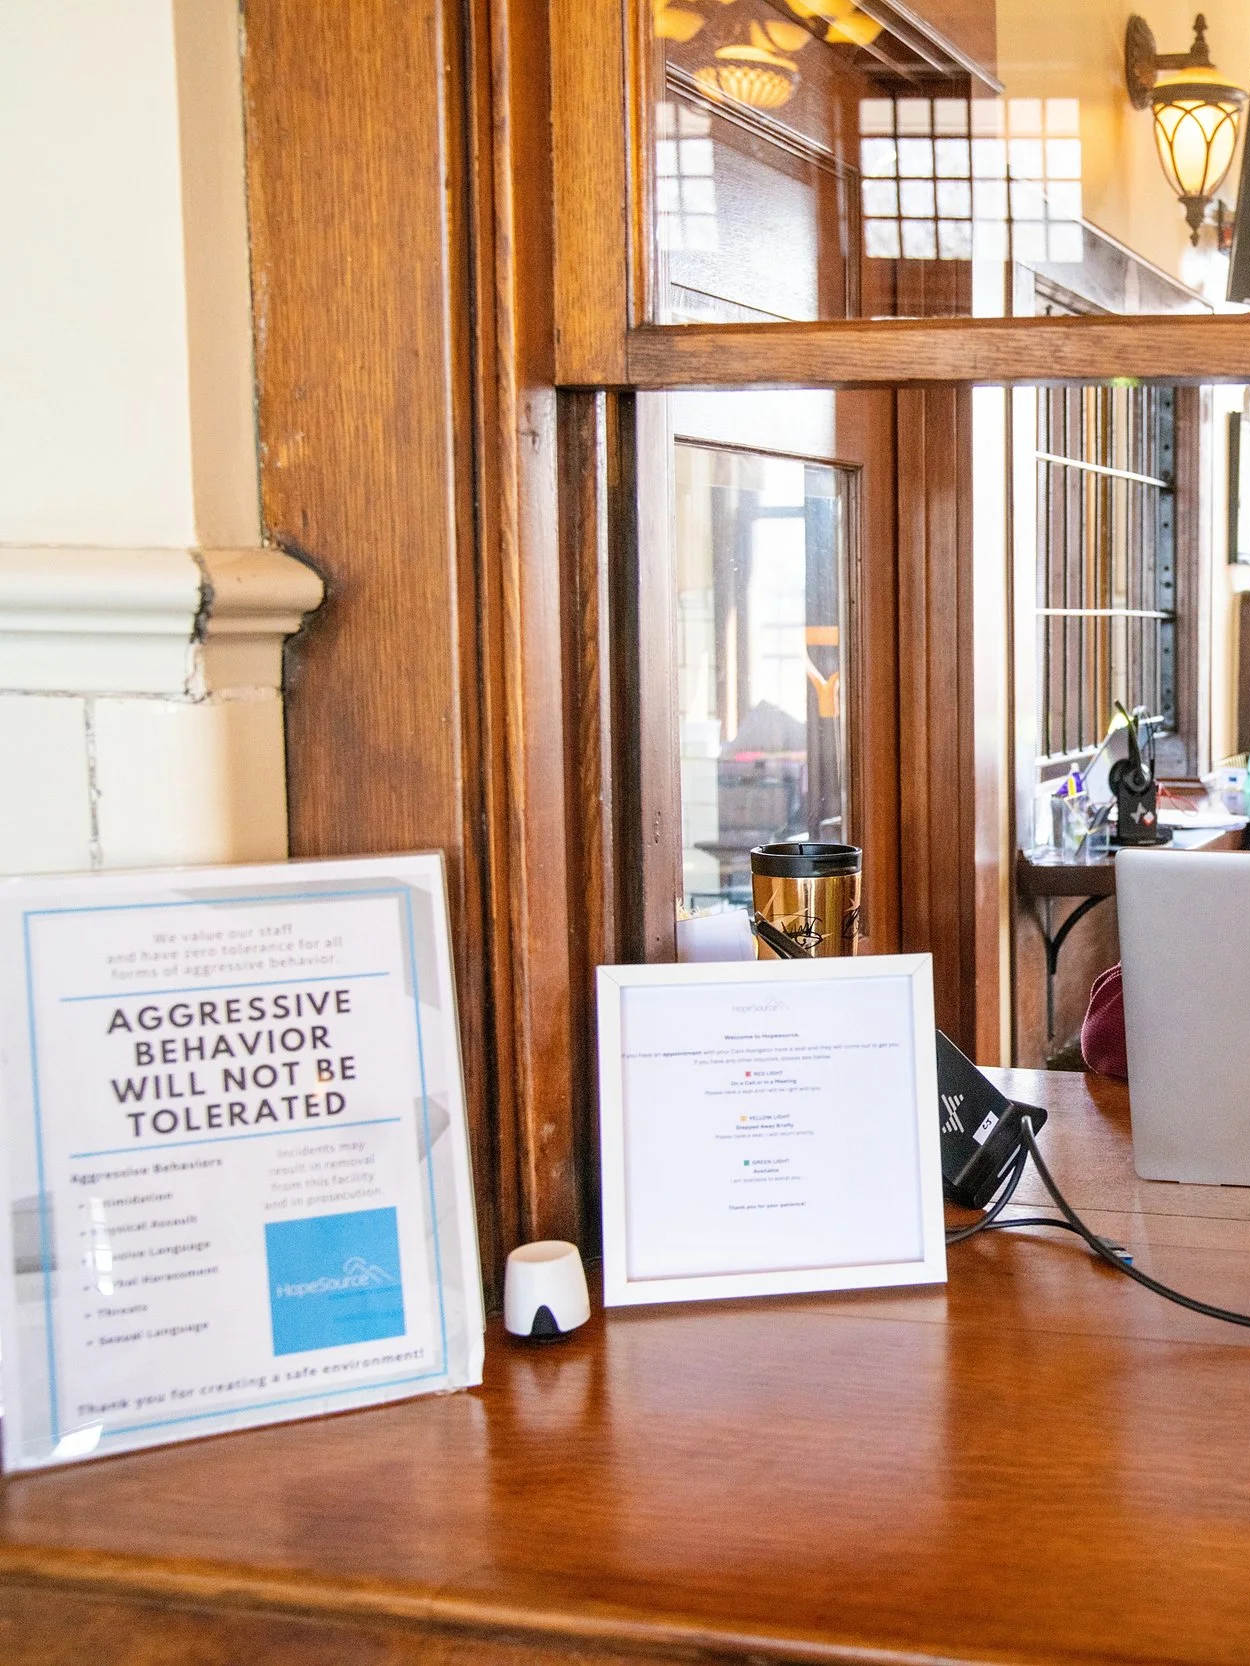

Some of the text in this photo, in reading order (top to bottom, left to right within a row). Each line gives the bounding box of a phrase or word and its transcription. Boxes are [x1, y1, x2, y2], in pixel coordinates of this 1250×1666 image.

[153, 924, 293, 944] We value our staff
[106, 936, 343, 965] and have zero tolerance for all
[111, 968, 158, 980] forms
[162, 966, 179, 977] of
[183, 960, 264, 977] aggressive
[106, 989, 351, 1035] AGGRESSIVE
[134, 1025, 332, 1067] BEHAVIOR
[662, 1050, 702, 1058] appointment
[111, 1056, 356, 1103] WILL NOT BE
[126, 1092, 346, 1138] TOLERATED
[276, 1142, 366, 1158] Incidents may
[69, 1158, 223, 1185] Aggressive Behaviors
[268, 1154, 376, 1176] result in removal
[271, 1172, 376, 1191] from this facility
[150, 1214, 198, 1229] Assault
[147, 1240, 211, 1257] Language
[141, 1265, 220, 1284] Harassment
[276, 1274, 370, 1298] HopeSource
[97, 1304, 149, 1319] Threats
[98, 1321, 210, 1346] Sexual Language
[78, 1399, 129, 1417] Thank
[136, 1393, 167, 1410] you
[171, 1388, 194, 1400] for
[200, 1375, 267, 1396] creating
[286, 1366, 318, 1380] safe
[323, 1348, 424, 1374] environment!
